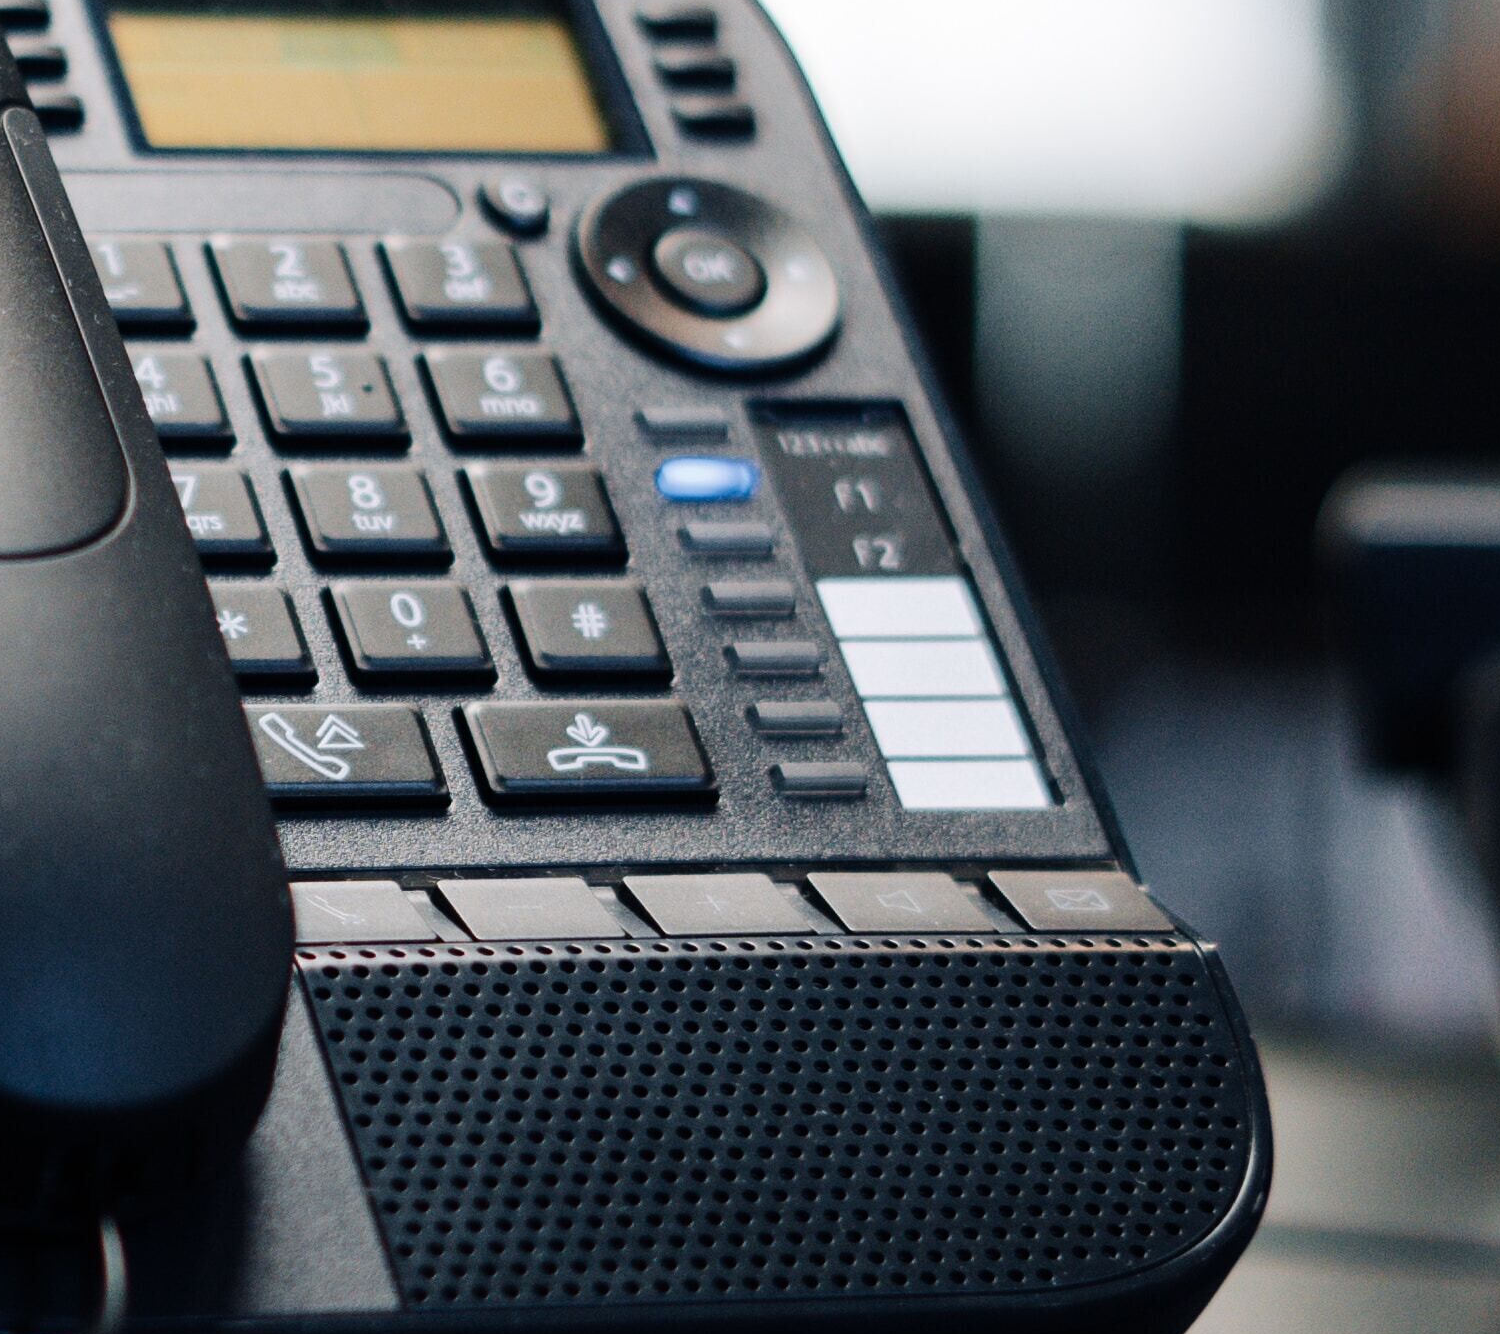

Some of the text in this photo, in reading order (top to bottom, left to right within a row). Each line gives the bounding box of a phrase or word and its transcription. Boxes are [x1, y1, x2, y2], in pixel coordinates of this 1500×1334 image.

[99, 243, 123, 277] 1
[270, 244, 304, 277] 2
[441, 243, 475, 277] 3
[273, 280, 321, 302] abc
[134, 356, 166, 389] 4
[310, 355, 340, 387] 5
[484, 357, 517, 392] 6
[321, 394, 350, 416] jkl
[479, 397, 539, 415] mno
[170, 475, 196, 509] 7
[347, 474, 382, 509] 8
[524, 471, 560, 508] 9
[834, 480, 876, 512] F1
[351, 514, 394, 532] tuv
[518, 511, 586, 535] wxyz
[853, 537, 900, 569] F2
[389, 592, 423, 628] 0
[571, 602, 606, 639] #
